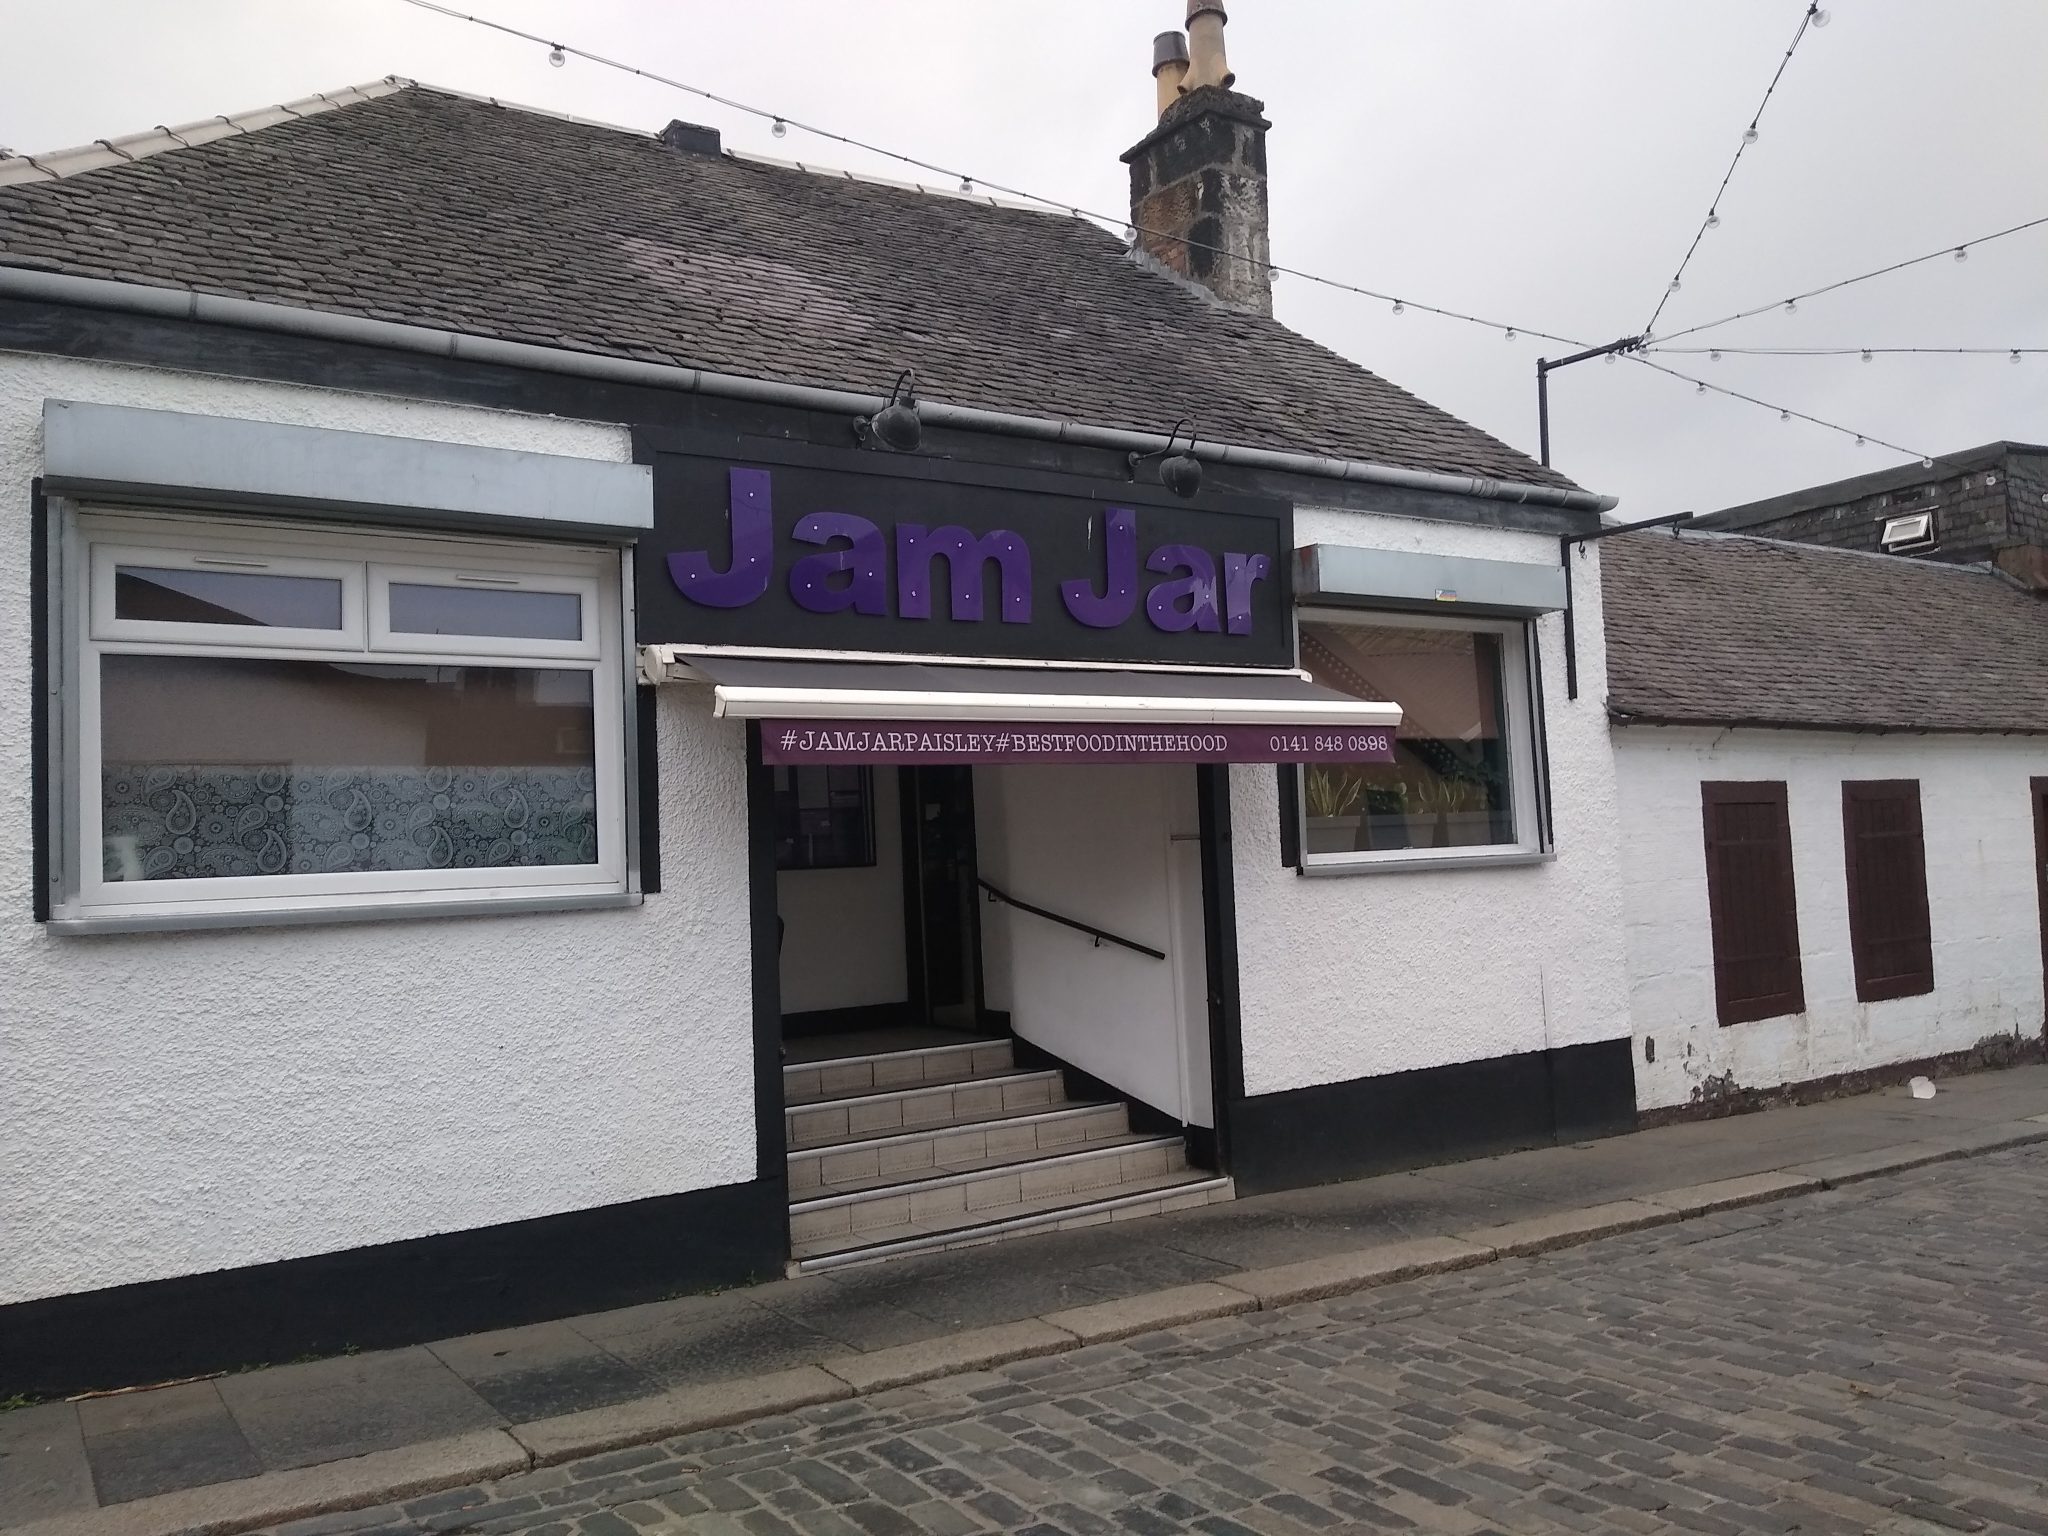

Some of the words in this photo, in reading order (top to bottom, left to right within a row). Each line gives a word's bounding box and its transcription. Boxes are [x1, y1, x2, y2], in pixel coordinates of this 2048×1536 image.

[667, 467, 1032, 624] Jam
[1061, 508, 1271, 635] Jar
[1269, 735, 1308, 752] 0141
[1314, 736, 1343, 752] 848
[1348, 735, 1388, 751] 0898
